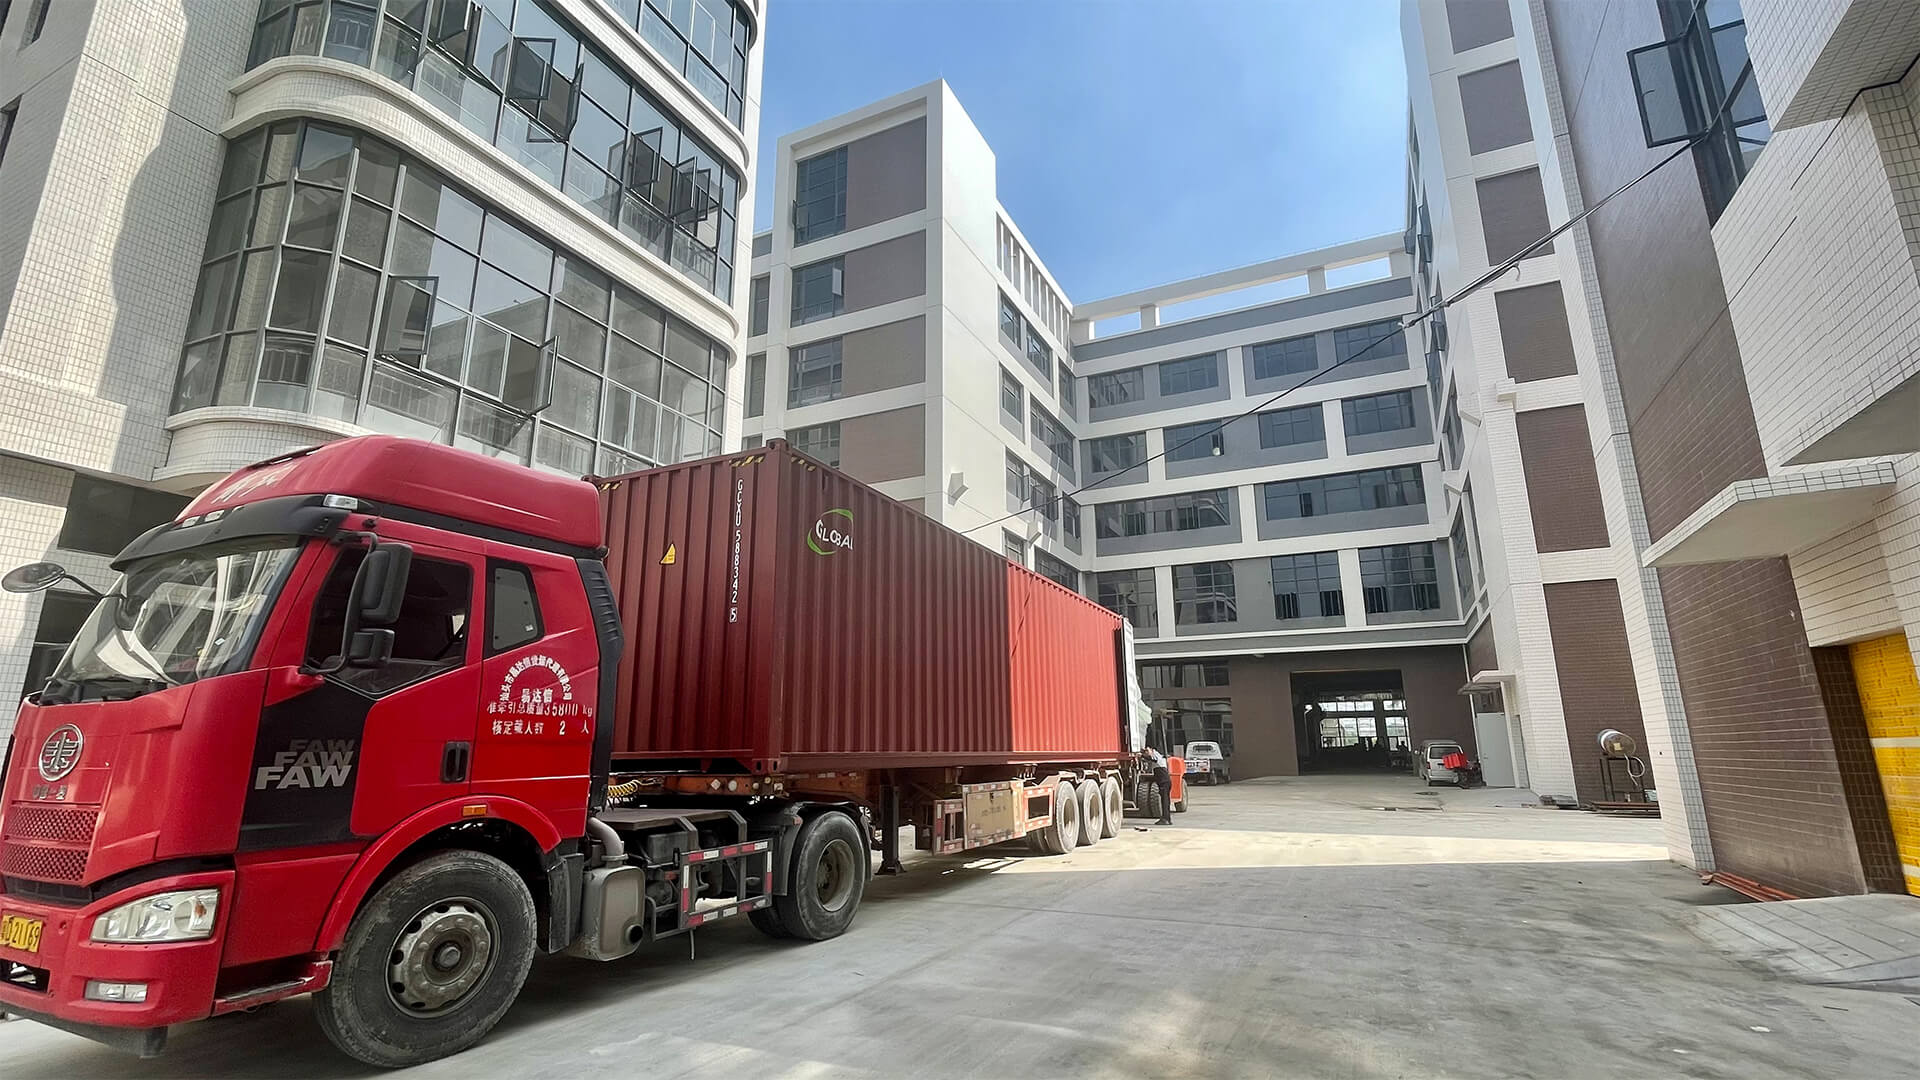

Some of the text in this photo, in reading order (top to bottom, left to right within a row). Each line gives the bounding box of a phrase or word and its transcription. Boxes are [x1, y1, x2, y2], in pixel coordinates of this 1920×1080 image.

[730, 479, 743, 622] GCXU 588342 5
[582, 705, 593, 717] kg
[559, 720, 566, 736] 2
[581, 719, 590, 735] 人
[273, 751, 354, 770] FAW
[254, 765, 352, 790] FAW
